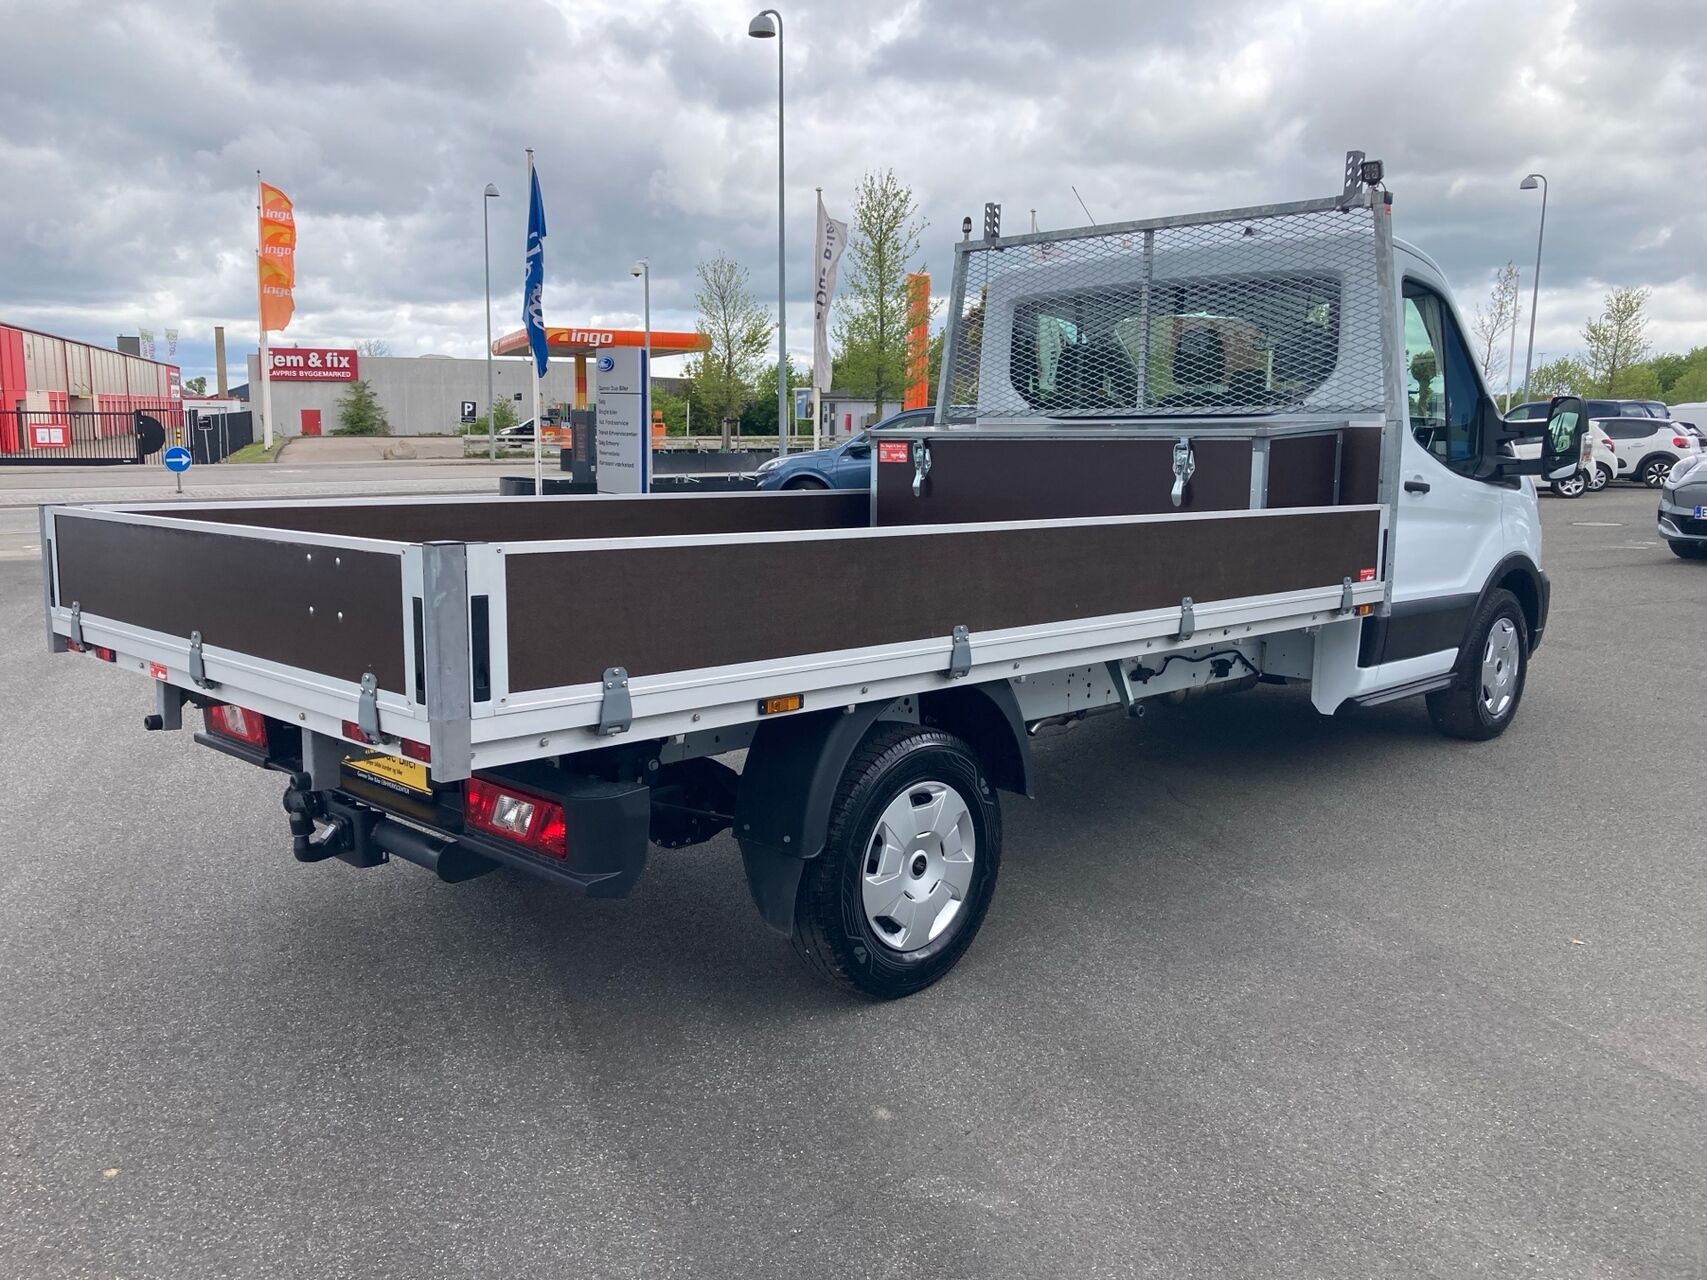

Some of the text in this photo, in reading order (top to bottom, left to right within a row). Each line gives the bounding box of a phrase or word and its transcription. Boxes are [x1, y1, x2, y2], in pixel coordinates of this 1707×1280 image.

[264, 244, 291, 257] ingo
[570, 329, 613, 347] ingo
[268, 351, 350, 369] jem & fix
[299, 370, 351, 378] BYGGEMARKED
[464, 402, 473, 416] P
